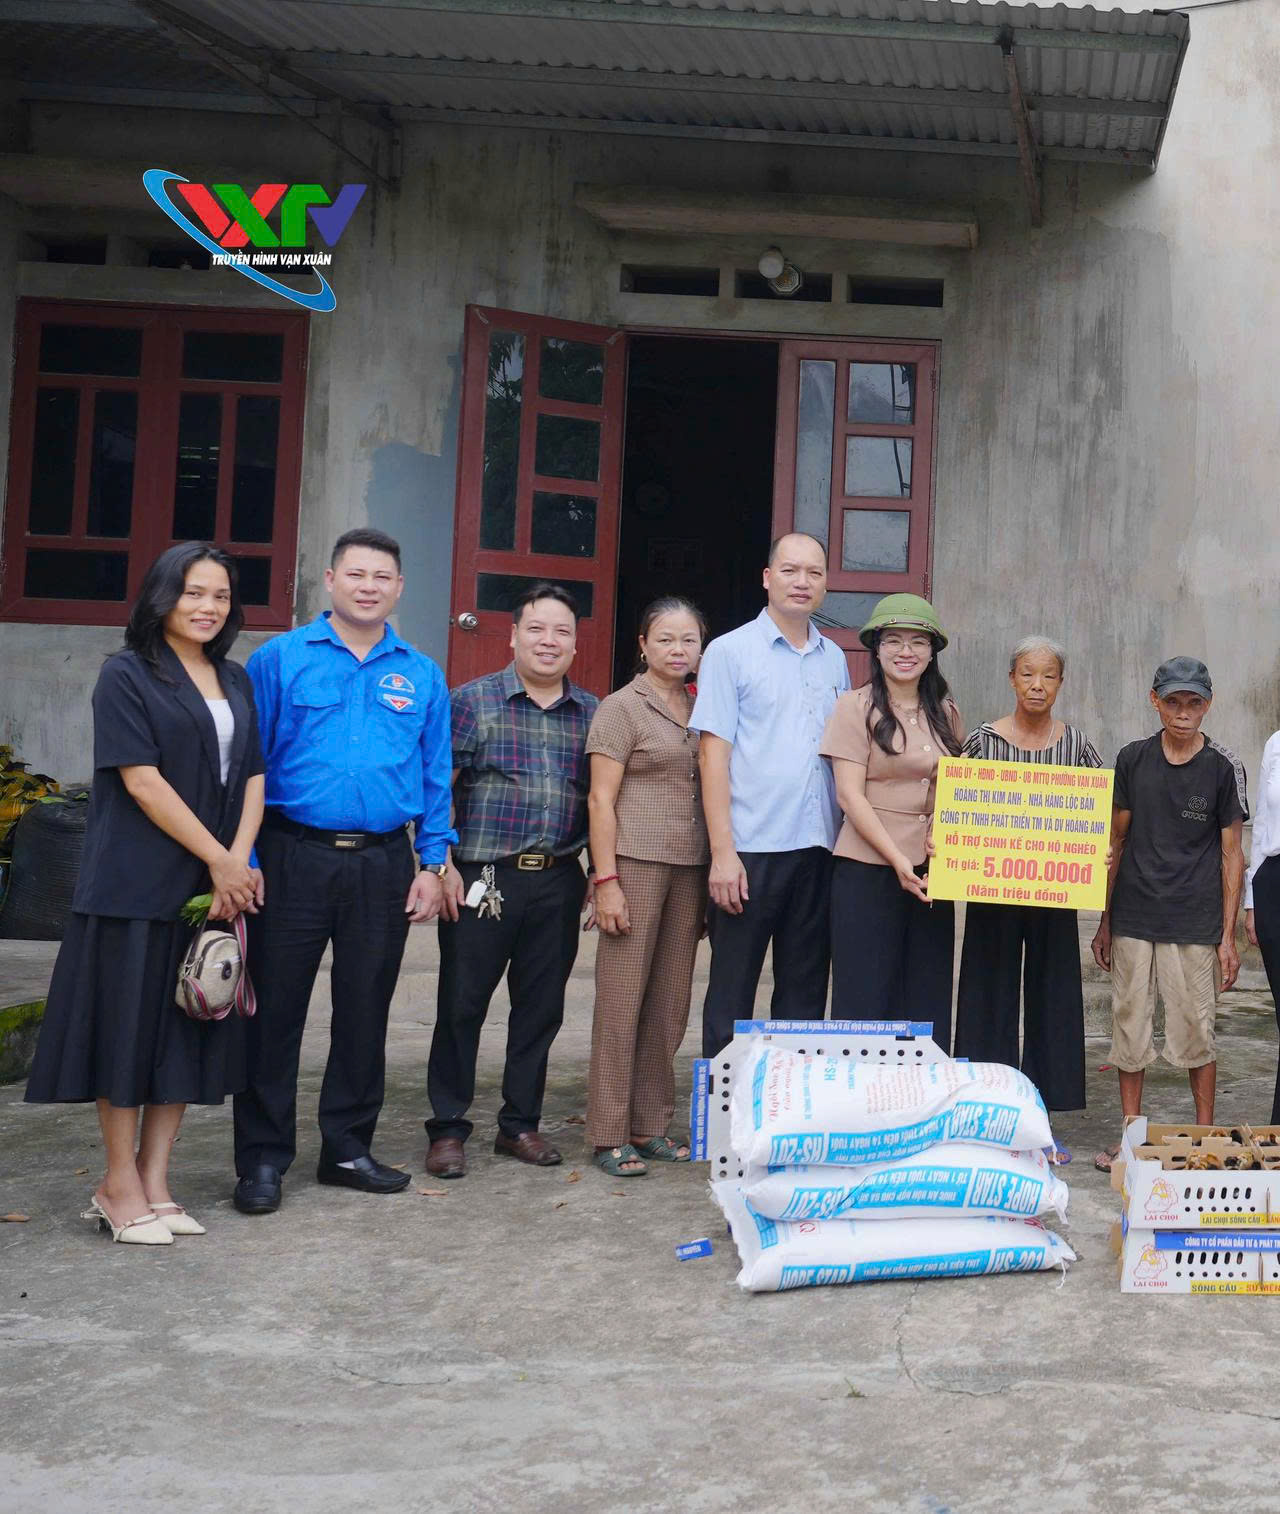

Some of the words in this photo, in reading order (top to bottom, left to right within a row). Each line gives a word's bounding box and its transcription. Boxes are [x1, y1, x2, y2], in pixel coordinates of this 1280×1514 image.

[977, 767, 995, 780] HĐND
[1000, 769, 1017, 782] UBND
[1022, 771, 1031, 783] UB
[1032, 771, 1049, 785] MTTQ
[1050, 770, 1076, 786] PHƯỜNG
[1077, 774, 1089, 789] VẠN
[1090, 773, 1108, 788] XUÂN
[953, 785, 977, 802] HOÀNG
[978, 789, 990, 806] THỊ
[991, 790, 1005, 804] KIM
[1007, 791, 1021, 805] ANH
[1028, 790, 1043, 806] NHÀ
[1044, 791, 1064, 808] HÀNG
[1065, 793, 1078, 812] LỘC
[939, 807, 959, 824] CÔNG
[961, 811, 969, 824] TY
[970, 812, 989, 826] TNHH
[990, 811, 1008, 827] PHÁT
[1010, 809, 1030, 829] TRIỂN
[1031, 816, 1042, 830] TM
[1044, 815, 1053, 830] VÀ
[1054, 818, 1064, 831] DV
[1064, 816, 1089, 833] HOÀNG
[1089, 820, 1105, 834] ANH
[945, 830, 959, 845] HỖ
[960, 833, 980, 849] TRỢ
[982, 836, 1007, 848] SINH
[1009, 835, 1022, 849] KẾ
[1024, 839, 1044, 851] CHO
[1047, 839, 1061, 854] HỘ
[1063, 840, 1097, 855] NGHÈO
[945, 858, 958, 870] Trị
[960, 858, 980, 871] giá:
[982, 855, 1092, 884] 5.000.000đ
[966, 883, 999, 898] (Năm
[1002, 887, 1030, 901] triệu
[1034, 887, 1068, 903] đồng)
[983, 1107, 1017, 1144] HOPE
[971, 1171, 1008, 1207] STAR
[1004, 1176, 1041, 1214] HOPE
[1202, 1216, 1212, 1224] LAI
[1214, 1216, 1228, 1225] CHỌI
[1230, 1214, 1246, 1224] SÔNG
[1184, 1236, 1200, 1246] CÔNG
[1201, 1237, 1208, 1247] TY
[1192, 1283, 1216, 1292] SÔNG
